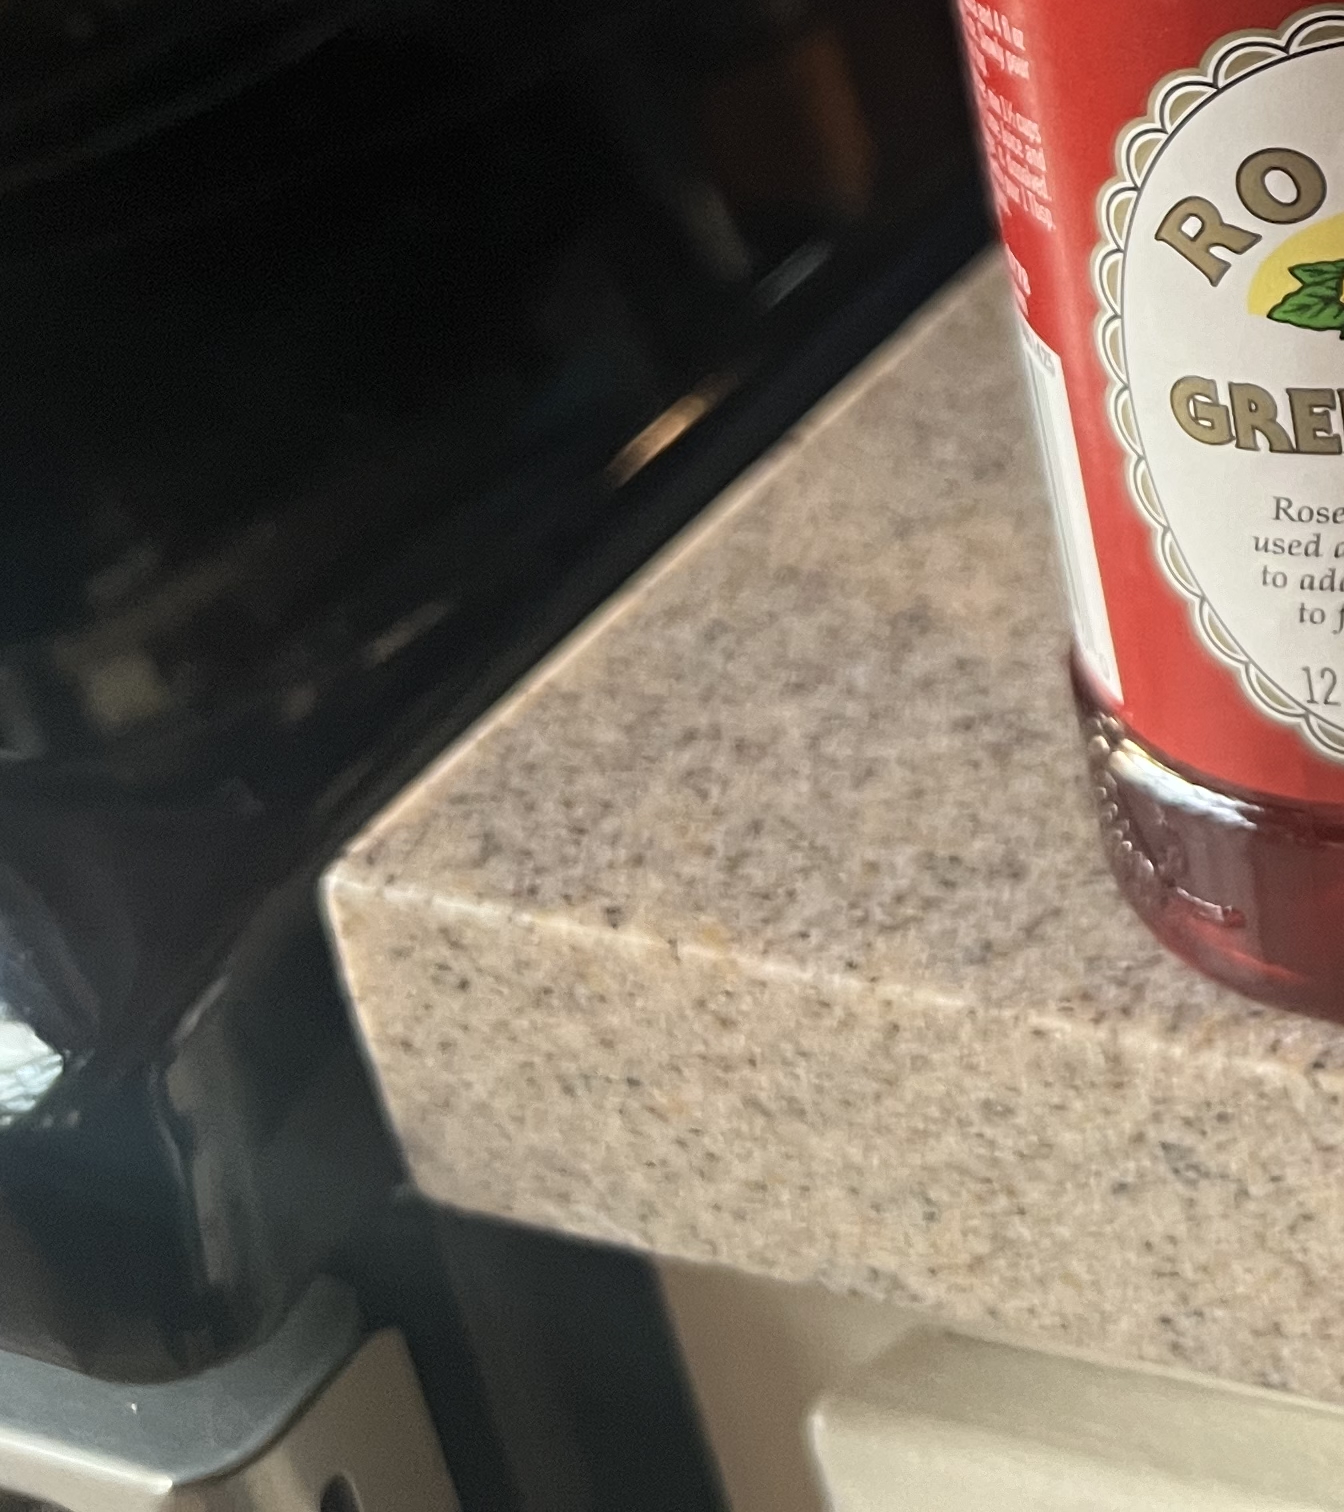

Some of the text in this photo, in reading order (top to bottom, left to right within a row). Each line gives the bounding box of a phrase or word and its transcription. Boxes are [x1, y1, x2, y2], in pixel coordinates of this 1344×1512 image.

[1253, 532, 1322, 558] used
[1262, 564, 1288, 589] to
[1299, 602, 1326, 625] to
[1302, 665, 1342, 707] 12
